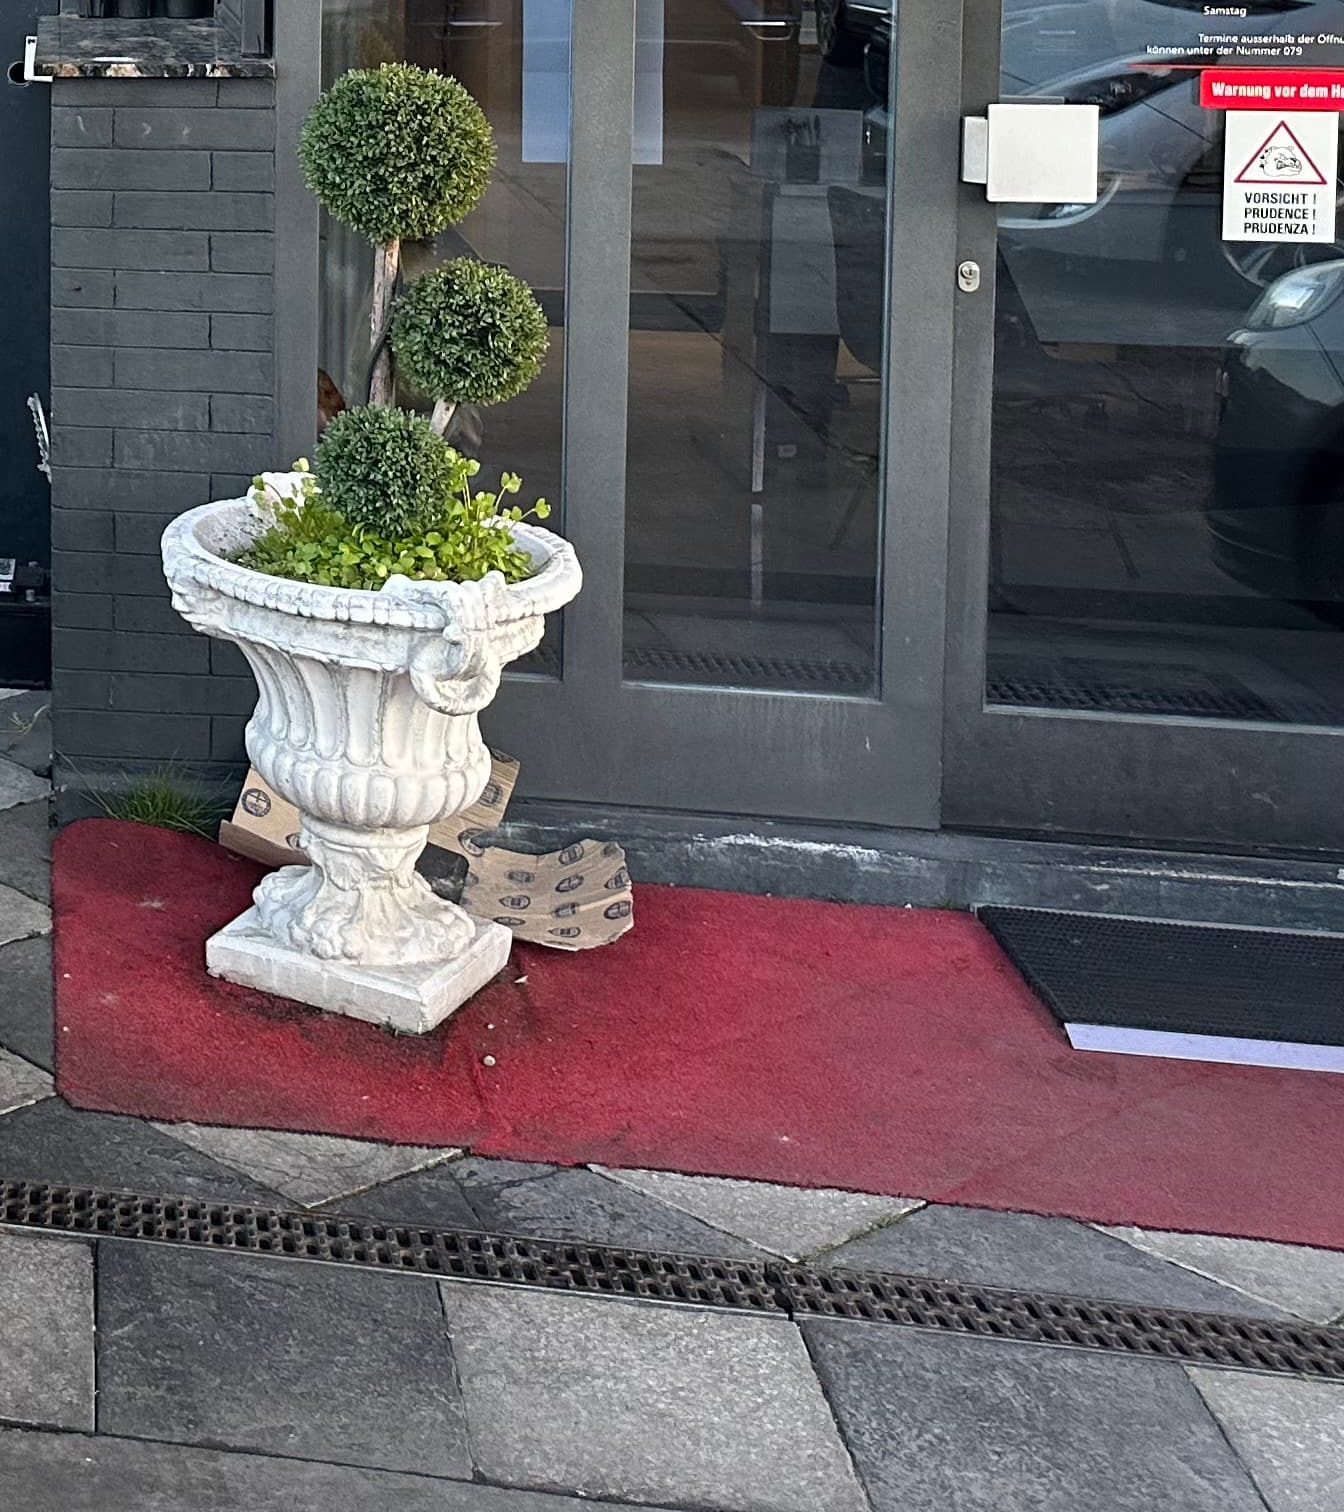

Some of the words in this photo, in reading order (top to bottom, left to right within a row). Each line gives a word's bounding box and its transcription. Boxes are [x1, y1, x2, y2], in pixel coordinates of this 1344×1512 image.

[1203, 6, 1247, 17] Samstag
[1198, 34, 1238, 43] Termine
[1240, 34, 1294, 44] ausserhalb
[1298, 34, 1314, 44] der
[1146, 45, 1184, 55] können
[1187, 46, 1214, 55] unter
[1216, 46, 1234, 55] der
[1236, 46, 1281, 56] Nummer
[1284, 46, 1303, 56] 079
[1211, 82, 1271, 99] Warnung
[1274, 85, 1297, 98] vor
[1299, 84, 1328, 98] dem
[1244, 191, 1308, 205] VORSICHT
[1244, 207, 1309, 220] PRUDENCE
[1243, 221, 1309, 235] PRUDENZA
